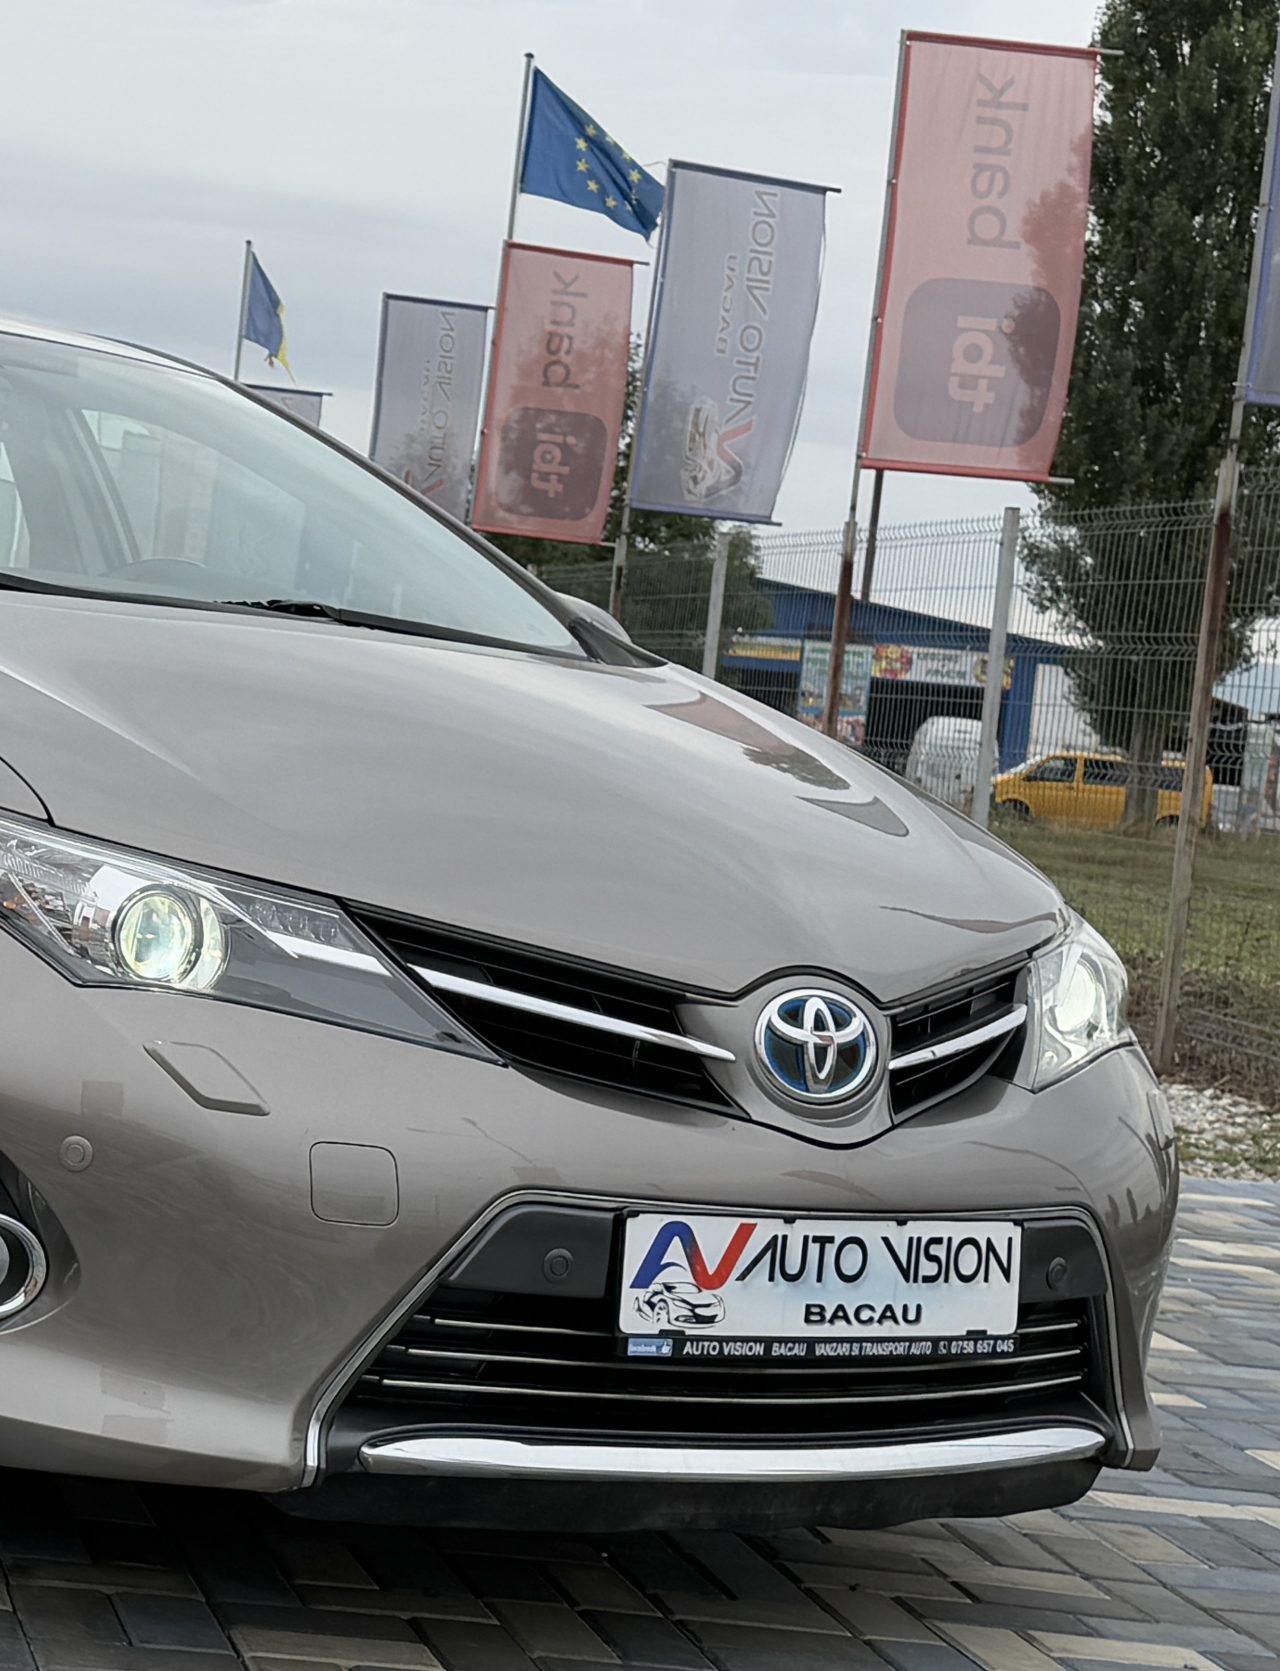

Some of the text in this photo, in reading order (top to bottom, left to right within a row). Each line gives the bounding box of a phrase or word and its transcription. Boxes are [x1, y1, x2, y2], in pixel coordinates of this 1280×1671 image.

[734, 1233, 1013, 1285] AUTO VISION
[803, 1303, 923, 1326] BACAU
[683, 1341, 719, 1356] AUTO
[722, 1341, 765, 1356] VISION
[771, 1342, 807, 1356] BACAU
[861, 1341, 910, 1356] TRANSPORT
[976, 1339, 994, 1354] 657
[996, 1338, 1014, 1353] 045
